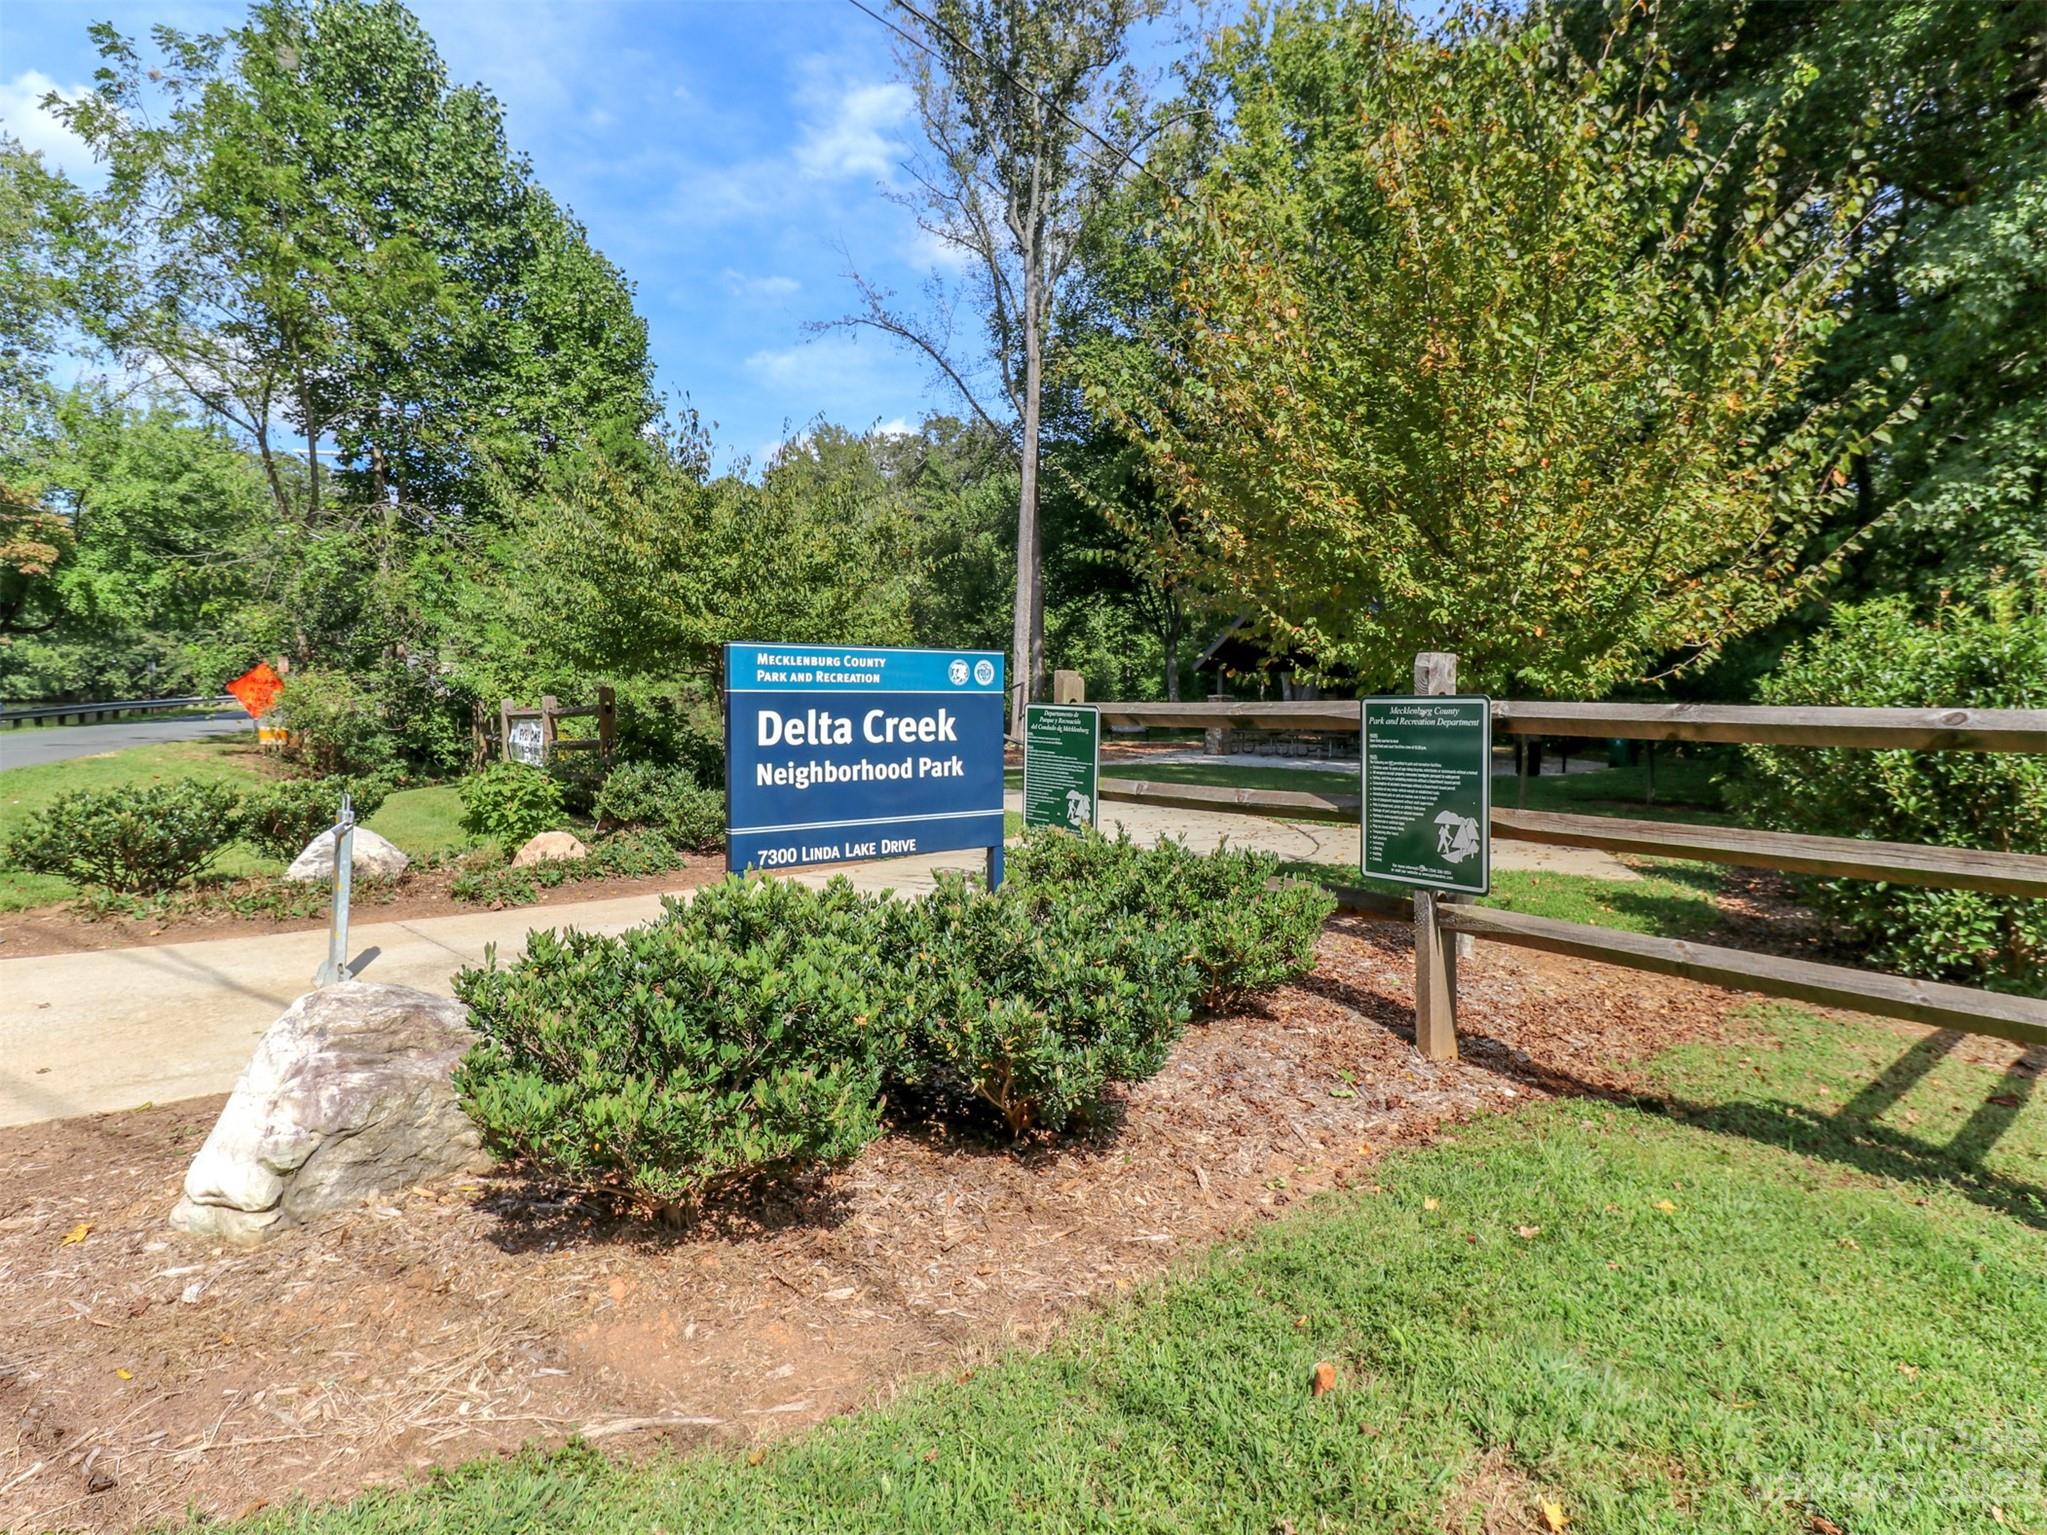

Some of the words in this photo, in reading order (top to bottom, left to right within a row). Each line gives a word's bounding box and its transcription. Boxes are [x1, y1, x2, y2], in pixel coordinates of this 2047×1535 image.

[757, 653, 841, 667] MECKLENBURG
[843, 655, 887, 668] COUNTY
[757, 670, 787, 682] PARK
[789, 672, 813, 683] AND
[816, 671, 881, 684] RECREATION
[1389, 706, 1433, 717] Mecklenburg
[1434, 706, 1460, 717] County
[757, 708, 852, 747] Delta
[862, 708, 957, 743] Creek
[1368, 716, 1385, 725] Park
[1385, 716, 1399, 725] and
[1399, 716, 1435, 726] Recreation
[1436, 717, 1480, 728] Department
[757, 757, 913, 789] Neighborhood
[919, 755, 964, 778] Park
[757, 848, 797, 866] 7300
[802, 845, 840, 862] LINDA
[845, 842, 876, 858] LAKE
[881, 839, 916, 854] DRIVE
